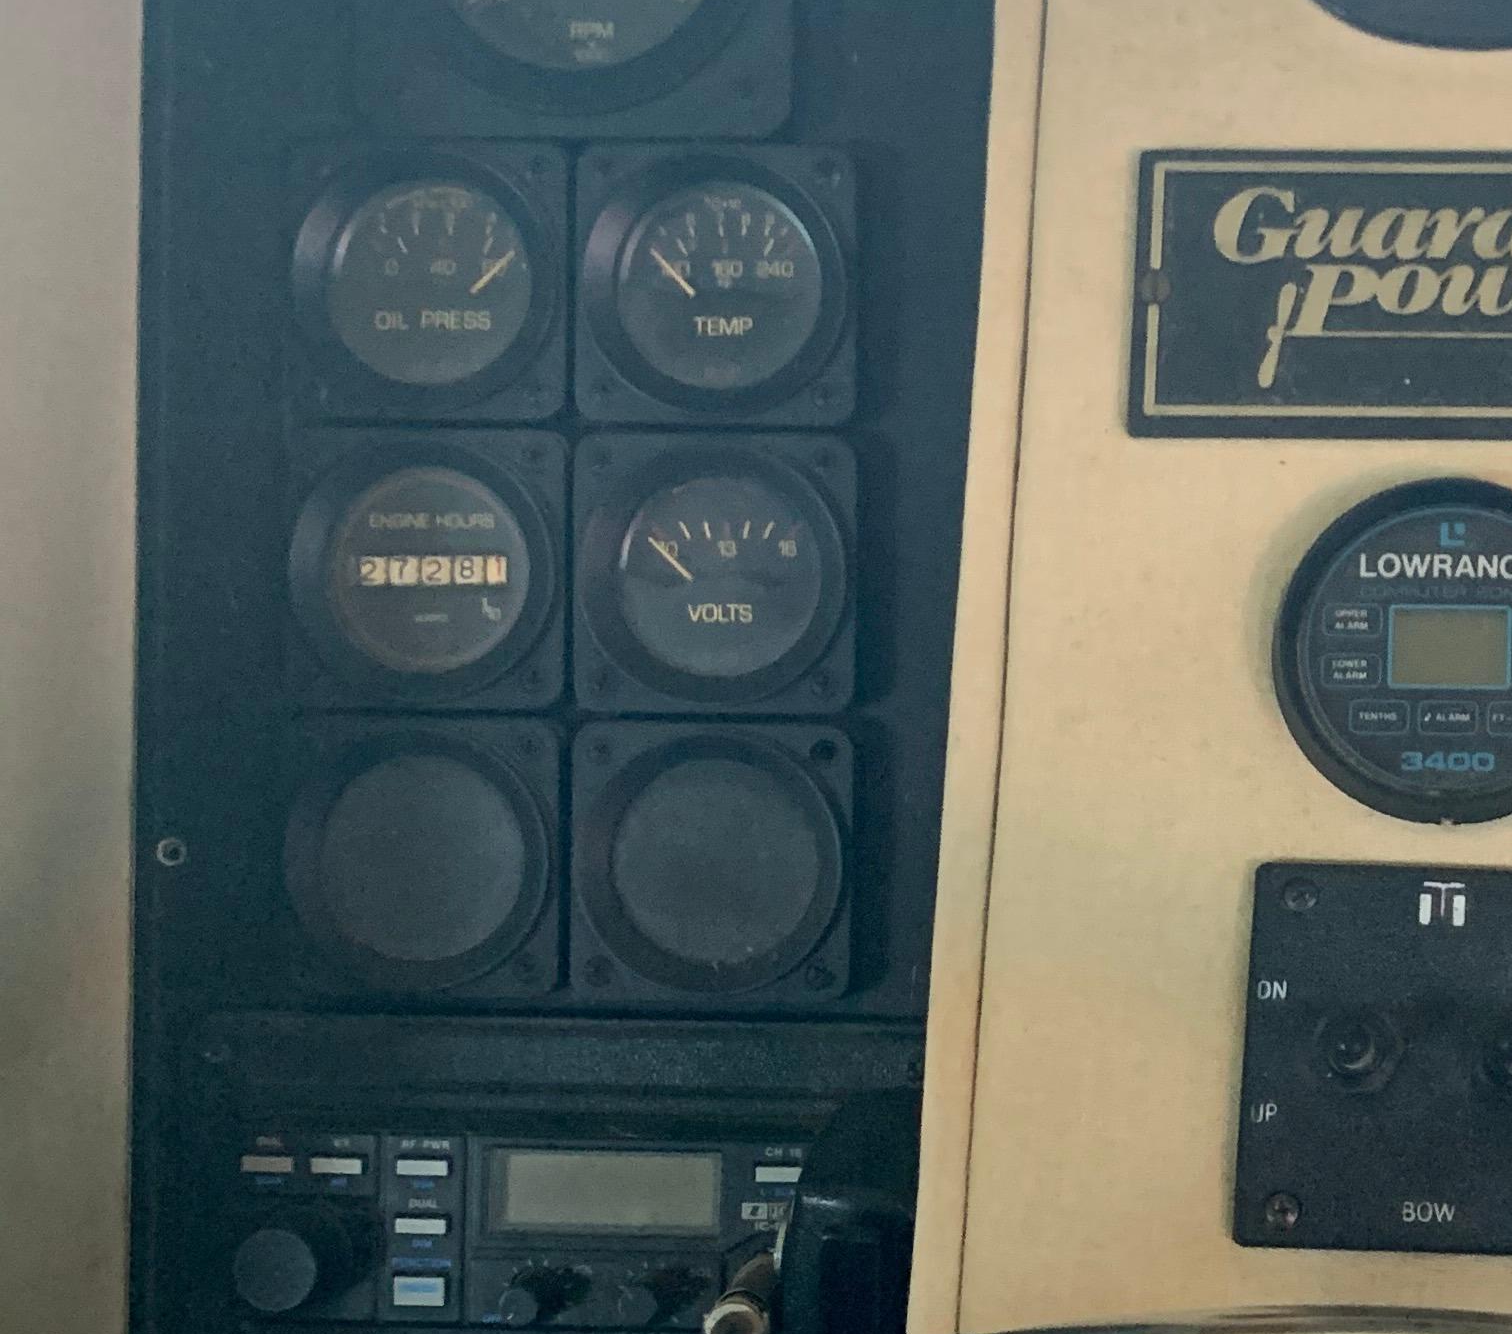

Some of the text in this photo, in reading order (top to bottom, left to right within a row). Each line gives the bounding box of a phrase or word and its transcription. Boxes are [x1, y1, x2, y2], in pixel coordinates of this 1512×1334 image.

[568, 21, 615, 40] RPM
[374, 310, 491, 331] OIL PRESS
[693, 315, 753, 337] TEMP
[369, 512, 496, 530] ENGINE HOURS
[718, 539, 738, 558] 13
[688, 603, 754, 624] VOLTS
[1333, 620, 1369, 631] ALARM
[1332, 670, 1368, 681] ALARM
[1435, 712, 1471, 723] ALARM
[1400, 751, 1496, 772] 3400
[1256, 979, 1288, 1000] DN
[1250, 1103, 1278, 1123] UP
[422, 1140, 450, 1150] PWR
[765, 1146, 783, 1157] CH
[408, 1198, 438, 1209] DUAL
[1401, 1201, 1456, 1223] BOW
